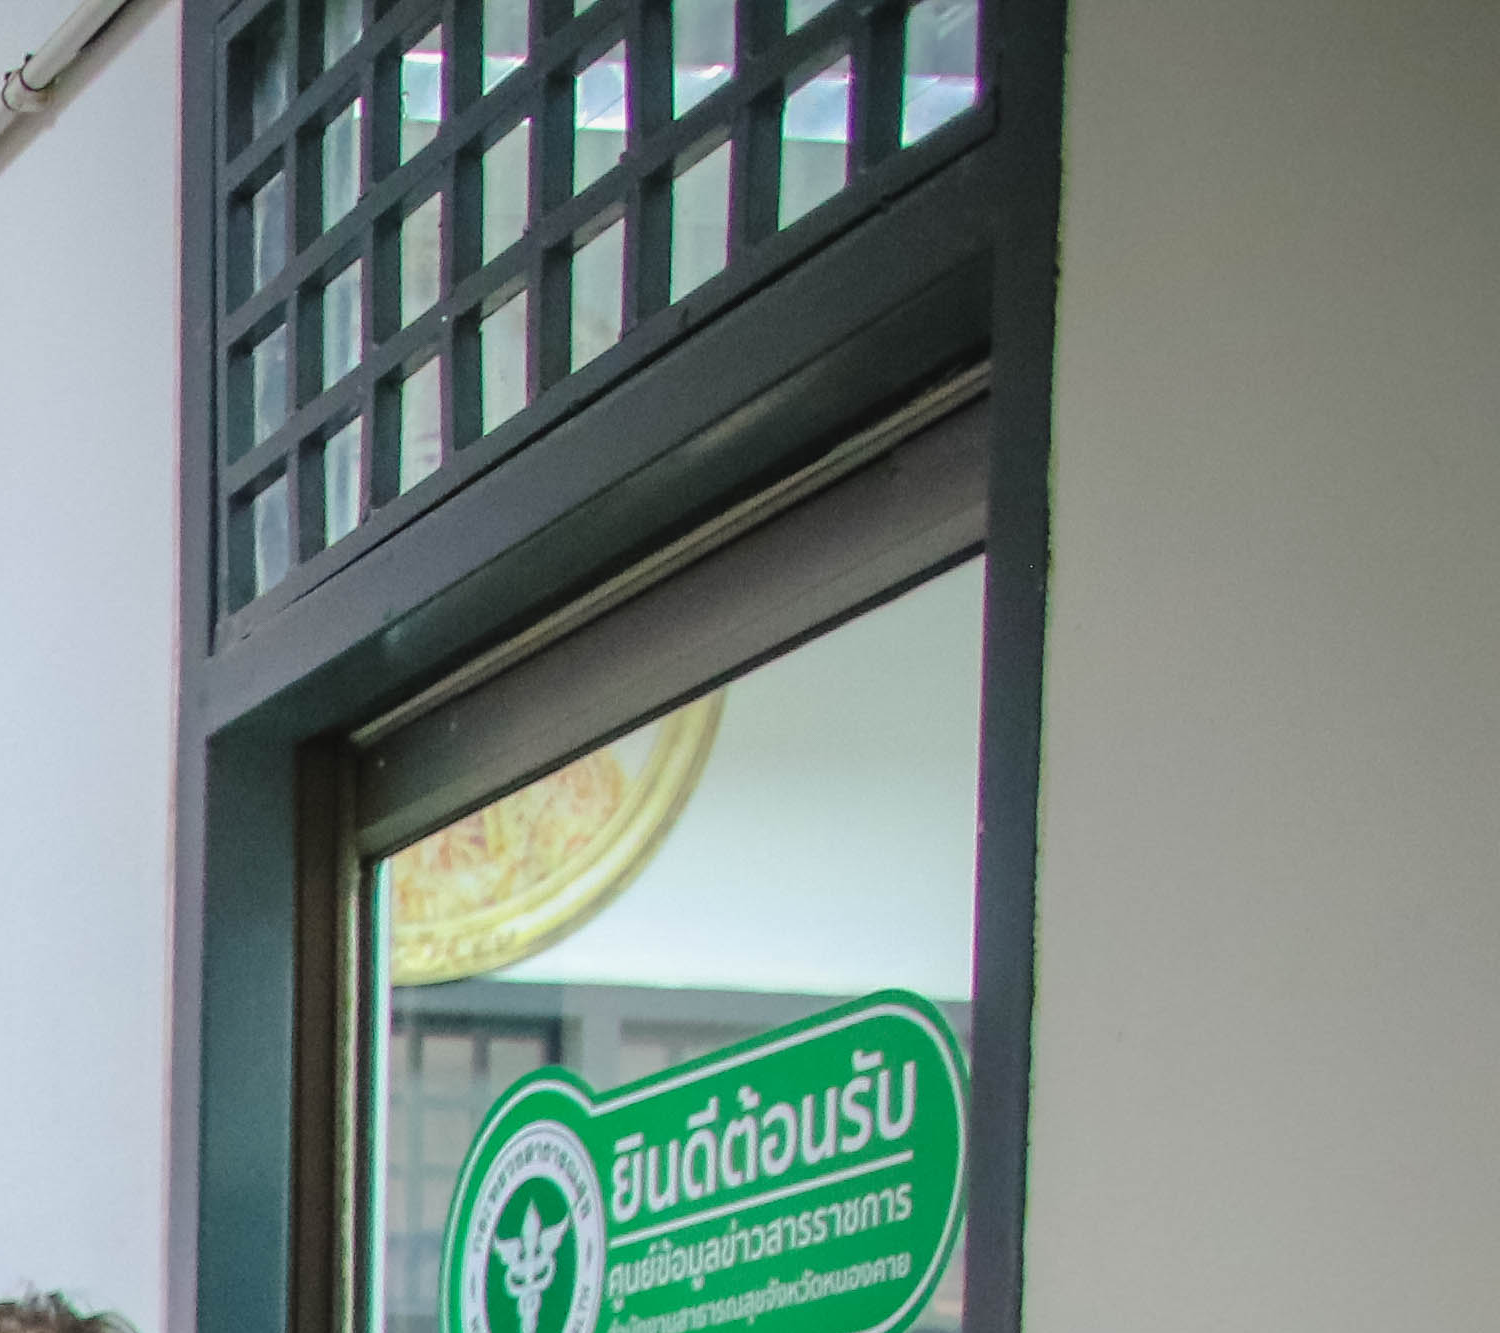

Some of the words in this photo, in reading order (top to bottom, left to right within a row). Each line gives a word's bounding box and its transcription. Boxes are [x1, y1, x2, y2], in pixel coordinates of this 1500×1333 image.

[609, 1048, 918, 1223] ยินดีต้อนรับ
[606, 1182, 912, 1313] ศูนย์ข้อมูลข่าวสารราชการ
